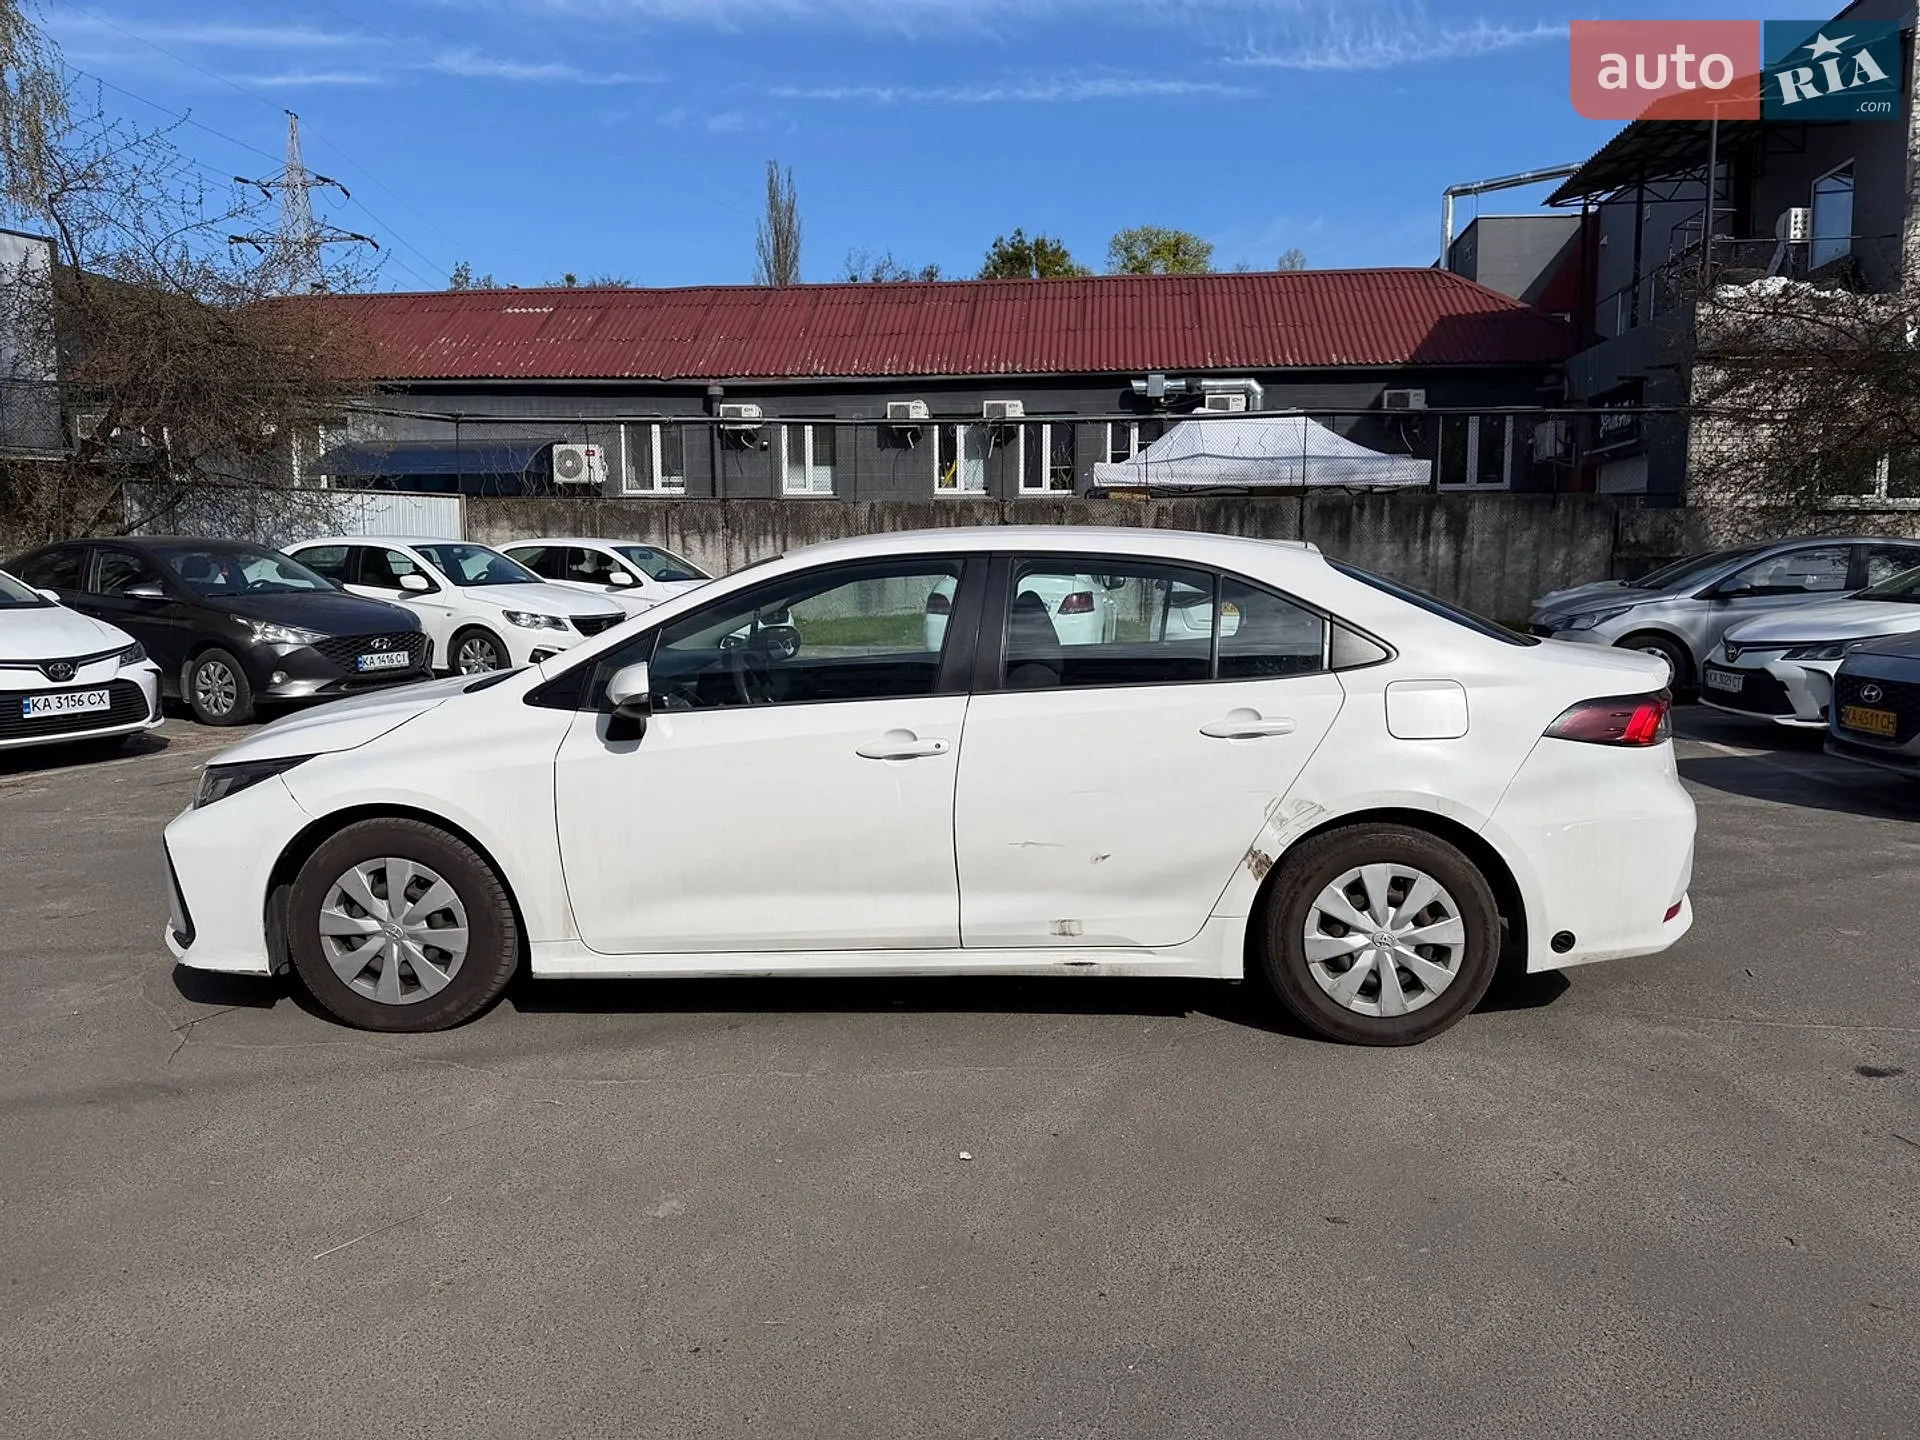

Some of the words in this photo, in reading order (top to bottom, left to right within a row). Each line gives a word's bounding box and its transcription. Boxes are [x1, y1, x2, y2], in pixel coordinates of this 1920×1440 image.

[362, 656, 375, 666] KA
[31, 697, 52, 711] KA
[55, 694, 85, 709] 3156
[87, 692, 106, 706] CX
